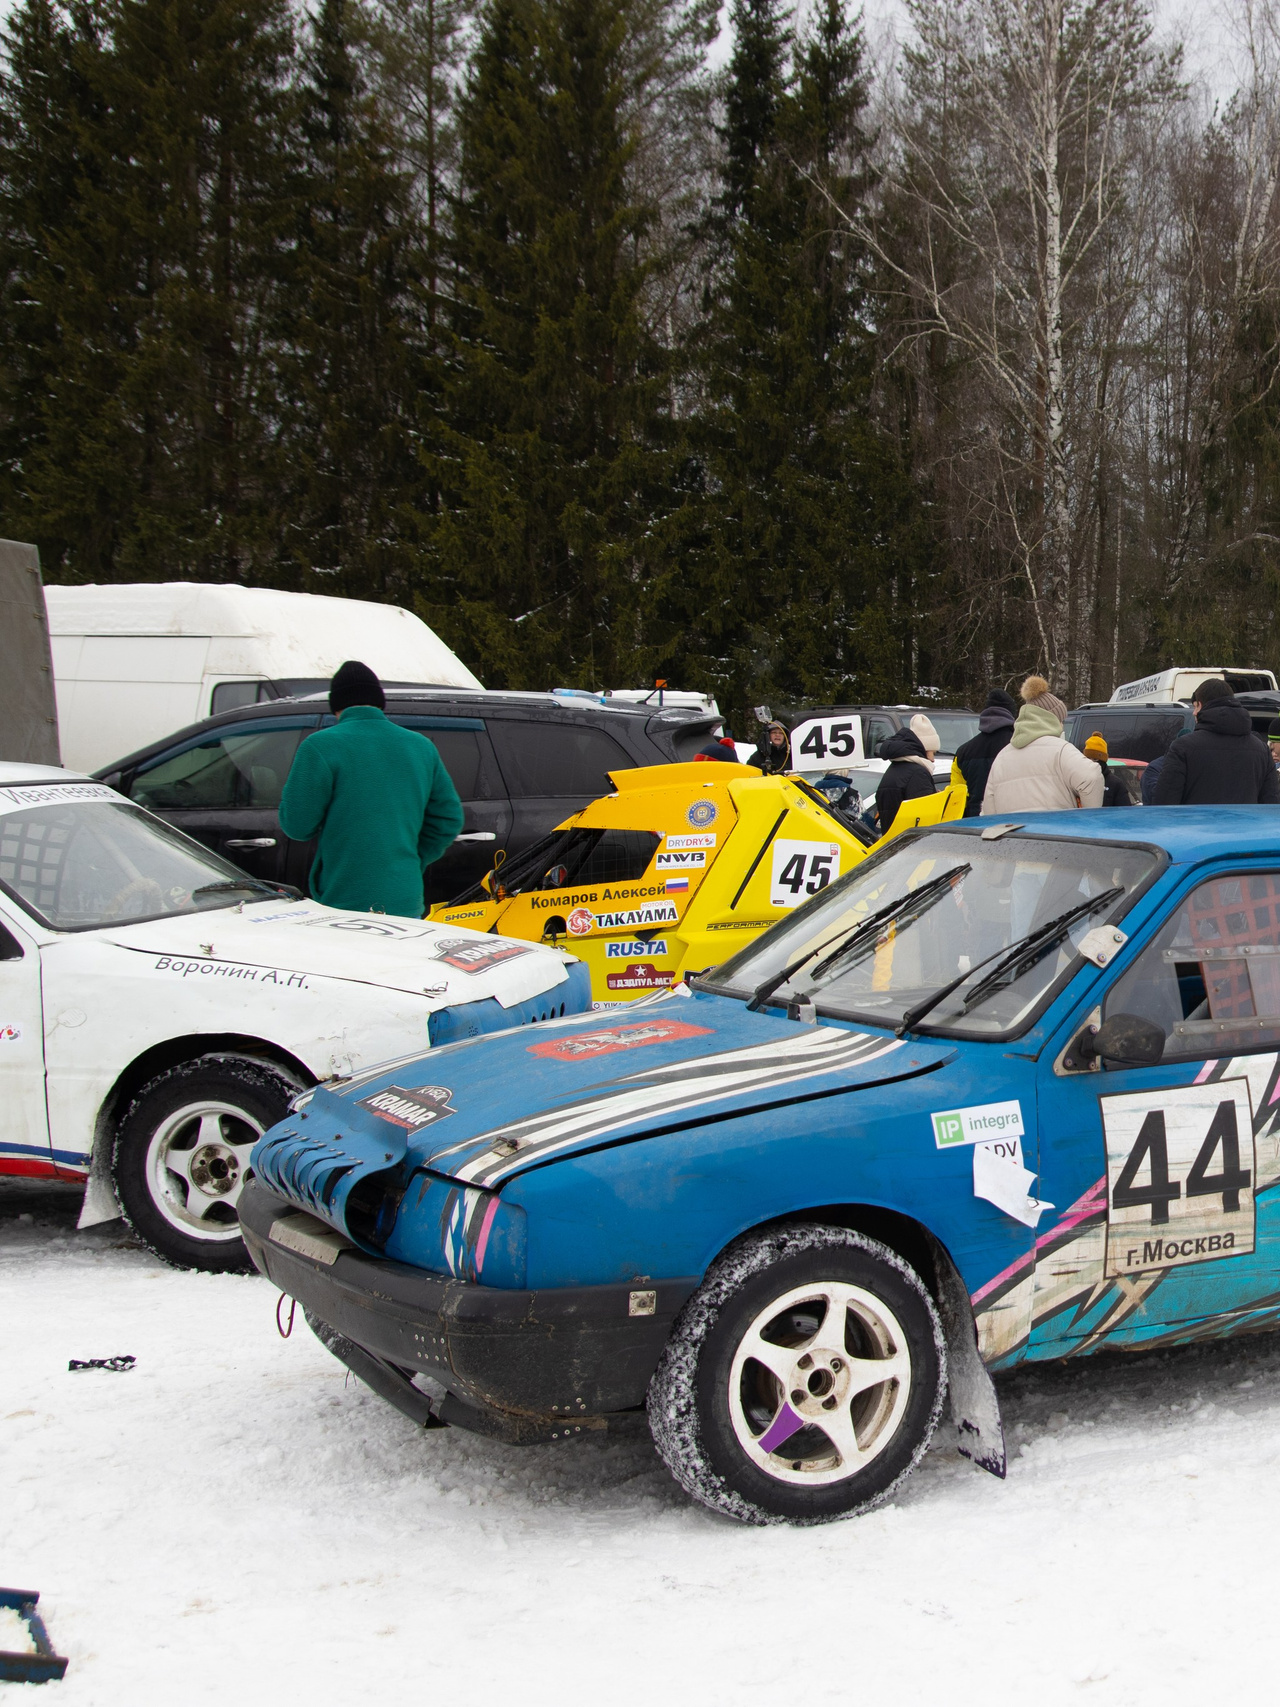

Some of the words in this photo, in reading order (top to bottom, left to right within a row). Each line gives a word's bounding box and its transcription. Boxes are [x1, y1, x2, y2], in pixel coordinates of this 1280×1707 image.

[800, 723, 856, 759] 45
[668, 838, 704, 847] DRYDRY
[657, 852, 705, 864] NWB
[778, 853, 834, 896] 45
[531, 892, 598, 910] Комаров
[602, 882, 666, 901] Алексей
[641, 901, 662, 909] MOTOR
[444, 910, 485, 922] SHONX
[596, 907, 677, 927] TAKAYAMA
[706, 921, 777, 930] PERFORMANC
[607, 941, 668, 957] RUSTA
[155, 957, 258, 980] Воронин
[261, 970, 309, 990] А.Н.
[366, 1092, 438, 1126] KRAMAR
[939, 1119, 960, 1140] IP
[968, 1112, 1020, 1131] integra
[1112, 1099, 1252, 1226] 44
[1126, 1231, 1236, 1267] г.Москва
